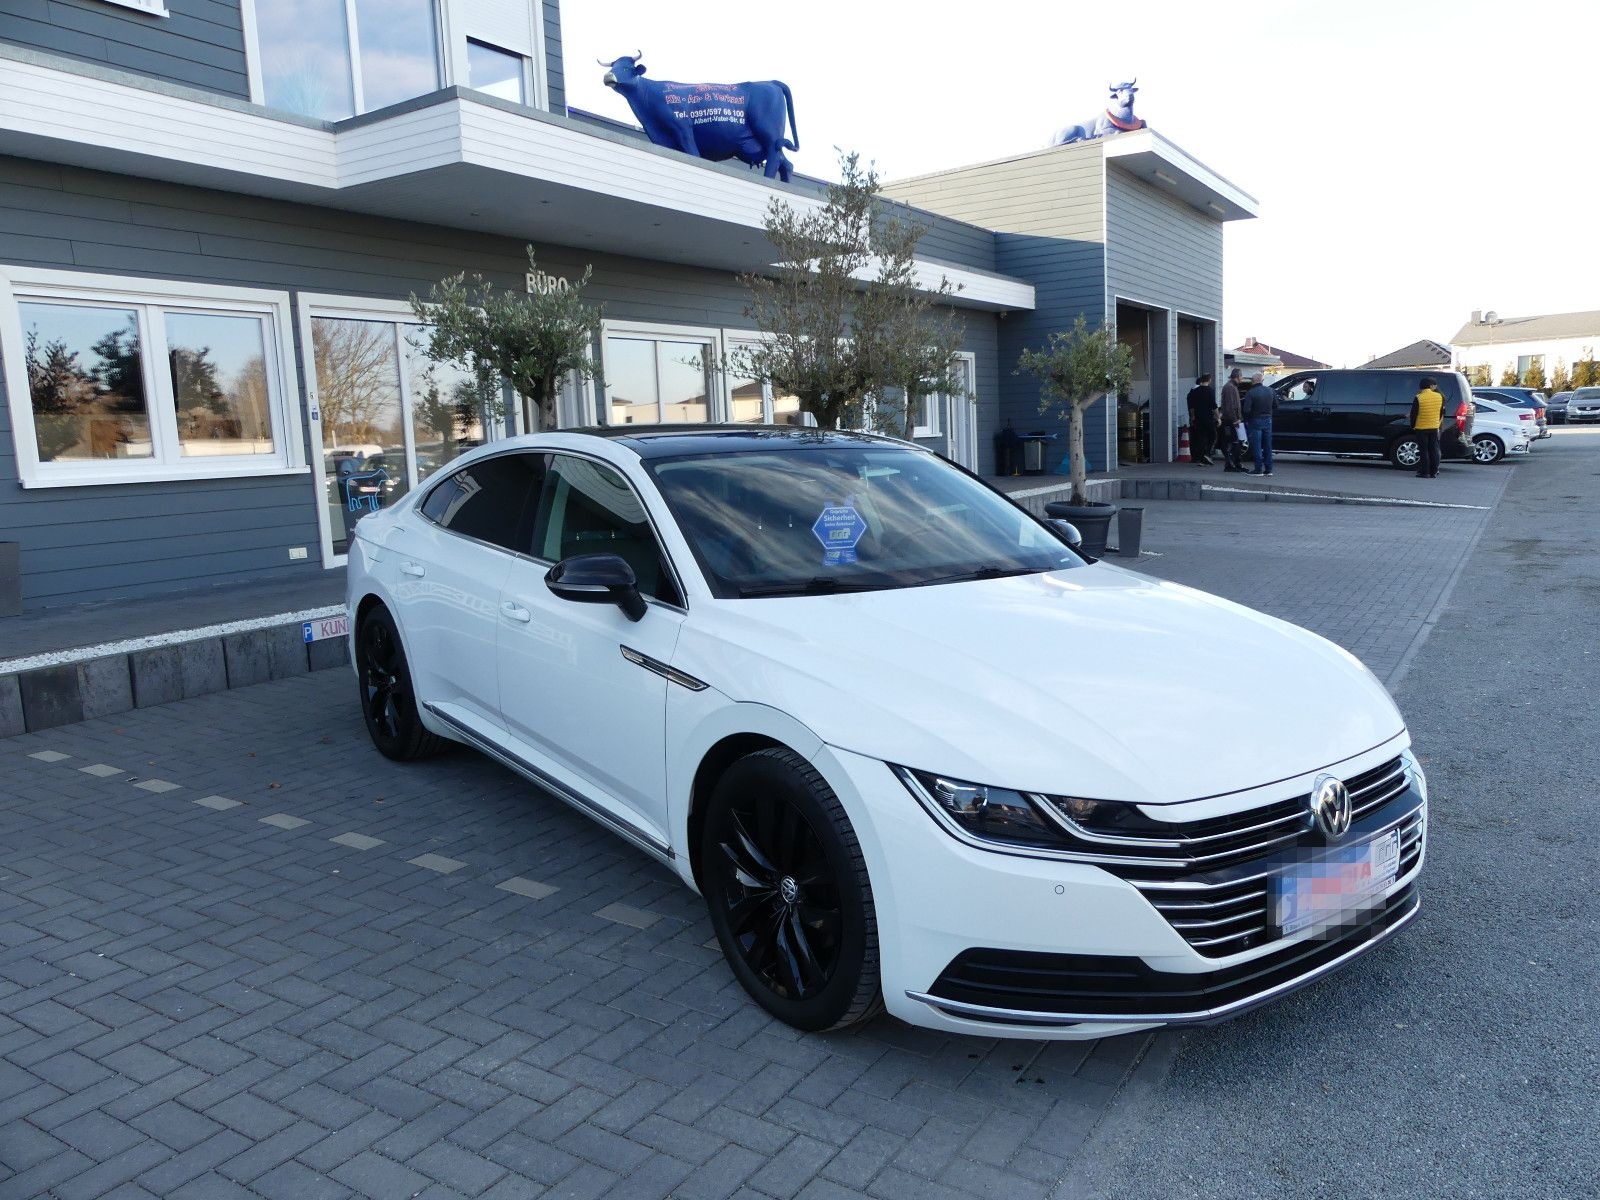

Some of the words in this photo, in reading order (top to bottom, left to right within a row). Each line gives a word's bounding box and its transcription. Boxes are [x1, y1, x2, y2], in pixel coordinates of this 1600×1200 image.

[690, 108, 722, 118] 0391/597
[733, 110, 745, 118] 100
[526, 270, 569, 296] BÜRO
[304, 627, 312, 639] P
